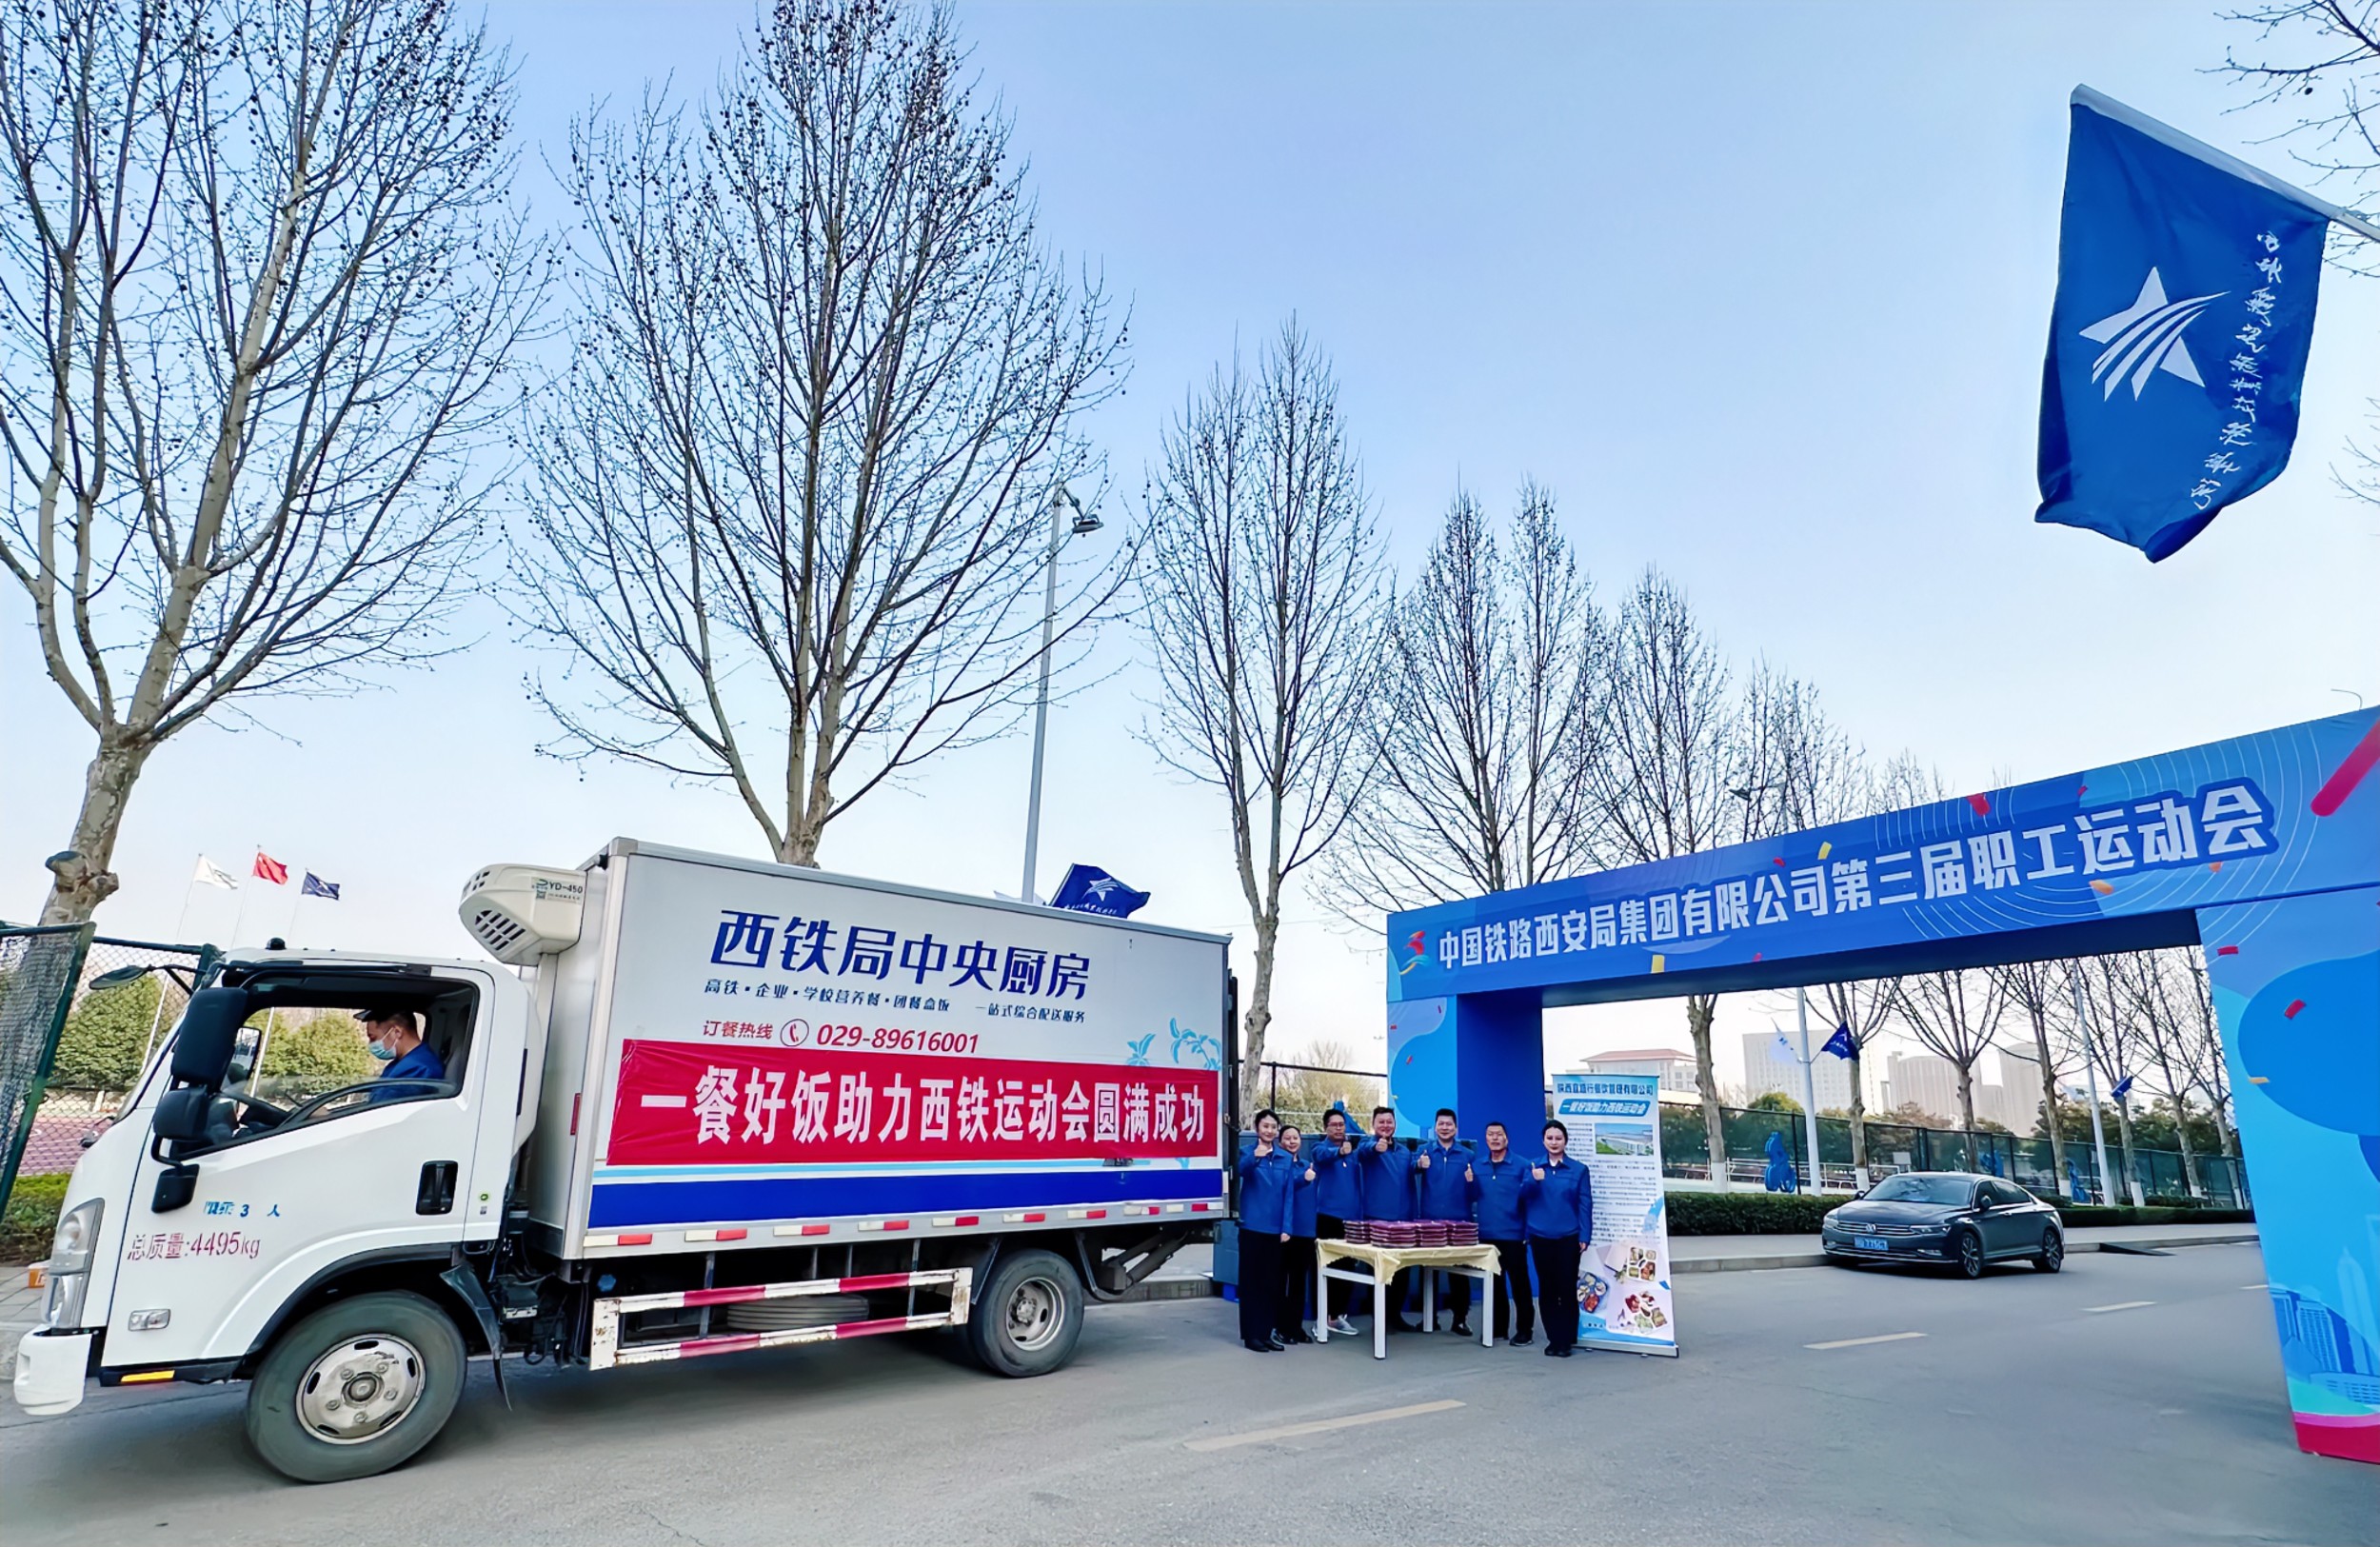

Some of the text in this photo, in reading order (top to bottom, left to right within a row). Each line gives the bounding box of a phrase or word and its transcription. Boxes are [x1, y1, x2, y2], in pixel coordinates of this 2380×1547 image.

[548, 882, 583, 893] YD-450
[1438, 785, 2269, 970] 中国铁路西安局集团有限公司第三届职工运动会
[710, 909, 1090, 1000] 西铁局中央厨房
[703, 1020, 980, 1054] 订餐热线 029-89616001
[640, 1064, 1205, 1145] 一餐好饭助力西铁运动会圆满成功
[240, 1204, 250, 1218] 3
[267, 1204, 281, 1218] 人
